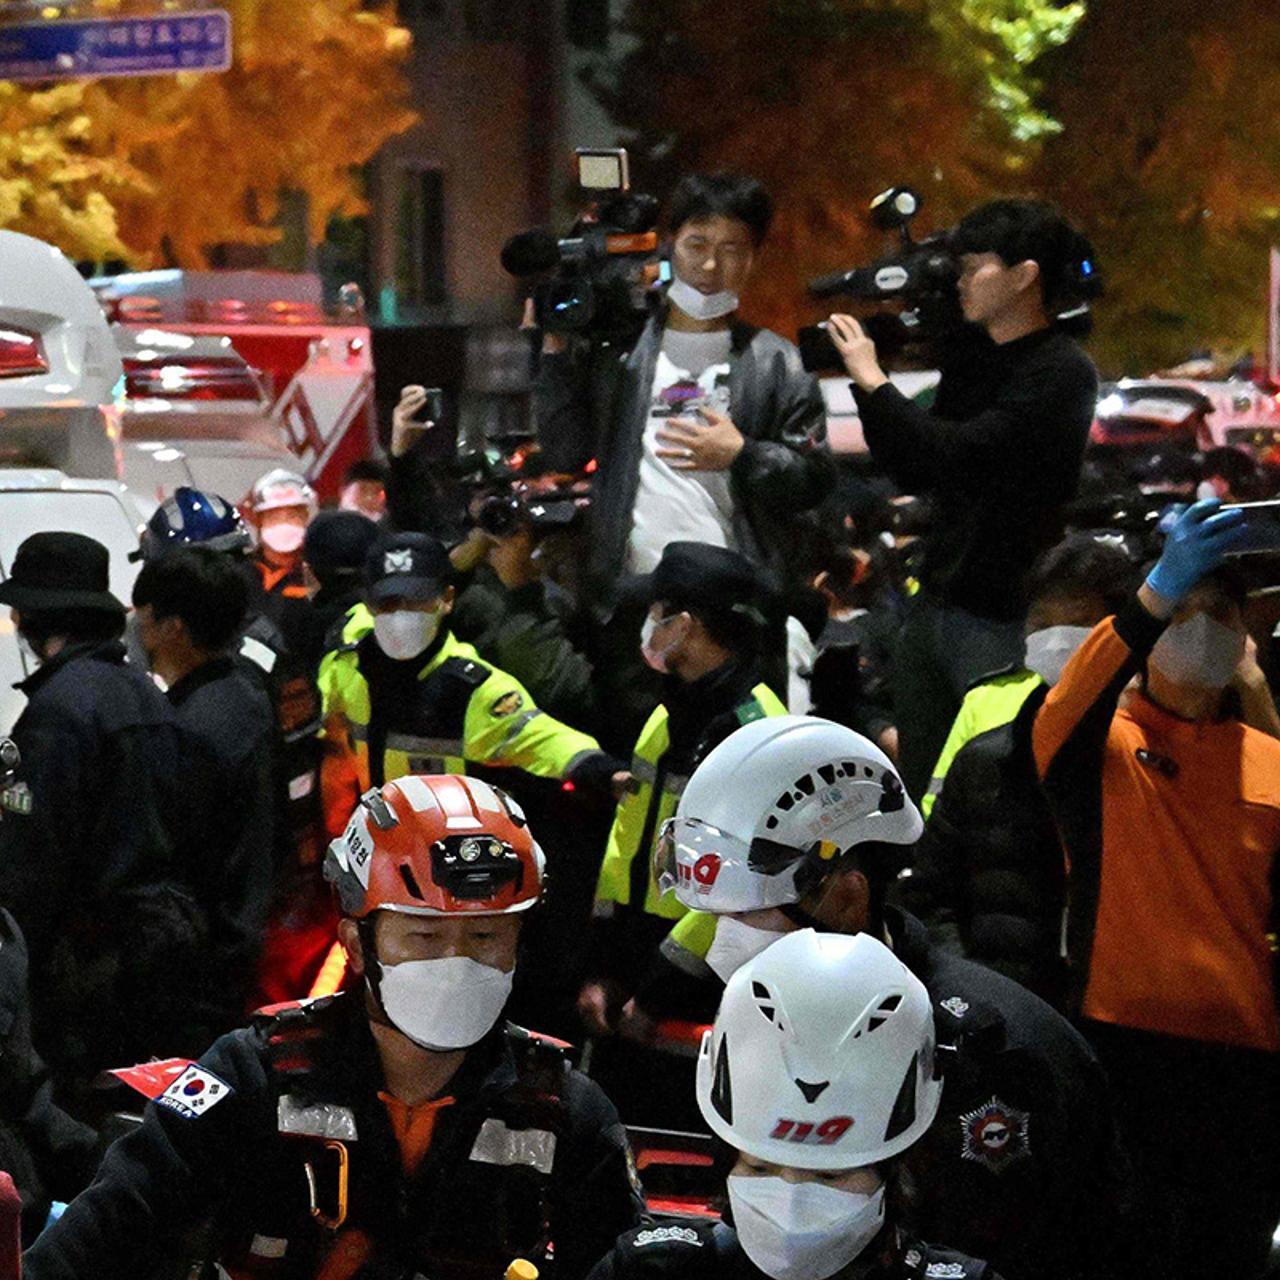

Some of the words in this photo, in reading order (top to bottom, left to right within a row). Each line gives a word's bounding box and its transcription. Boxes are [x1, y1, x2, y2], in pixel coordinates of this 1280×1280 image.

[677, 853, 722, 895] 119
[158, 1096, 193, 1118] KOREA
[769, 1115, 856, 1146] 119
